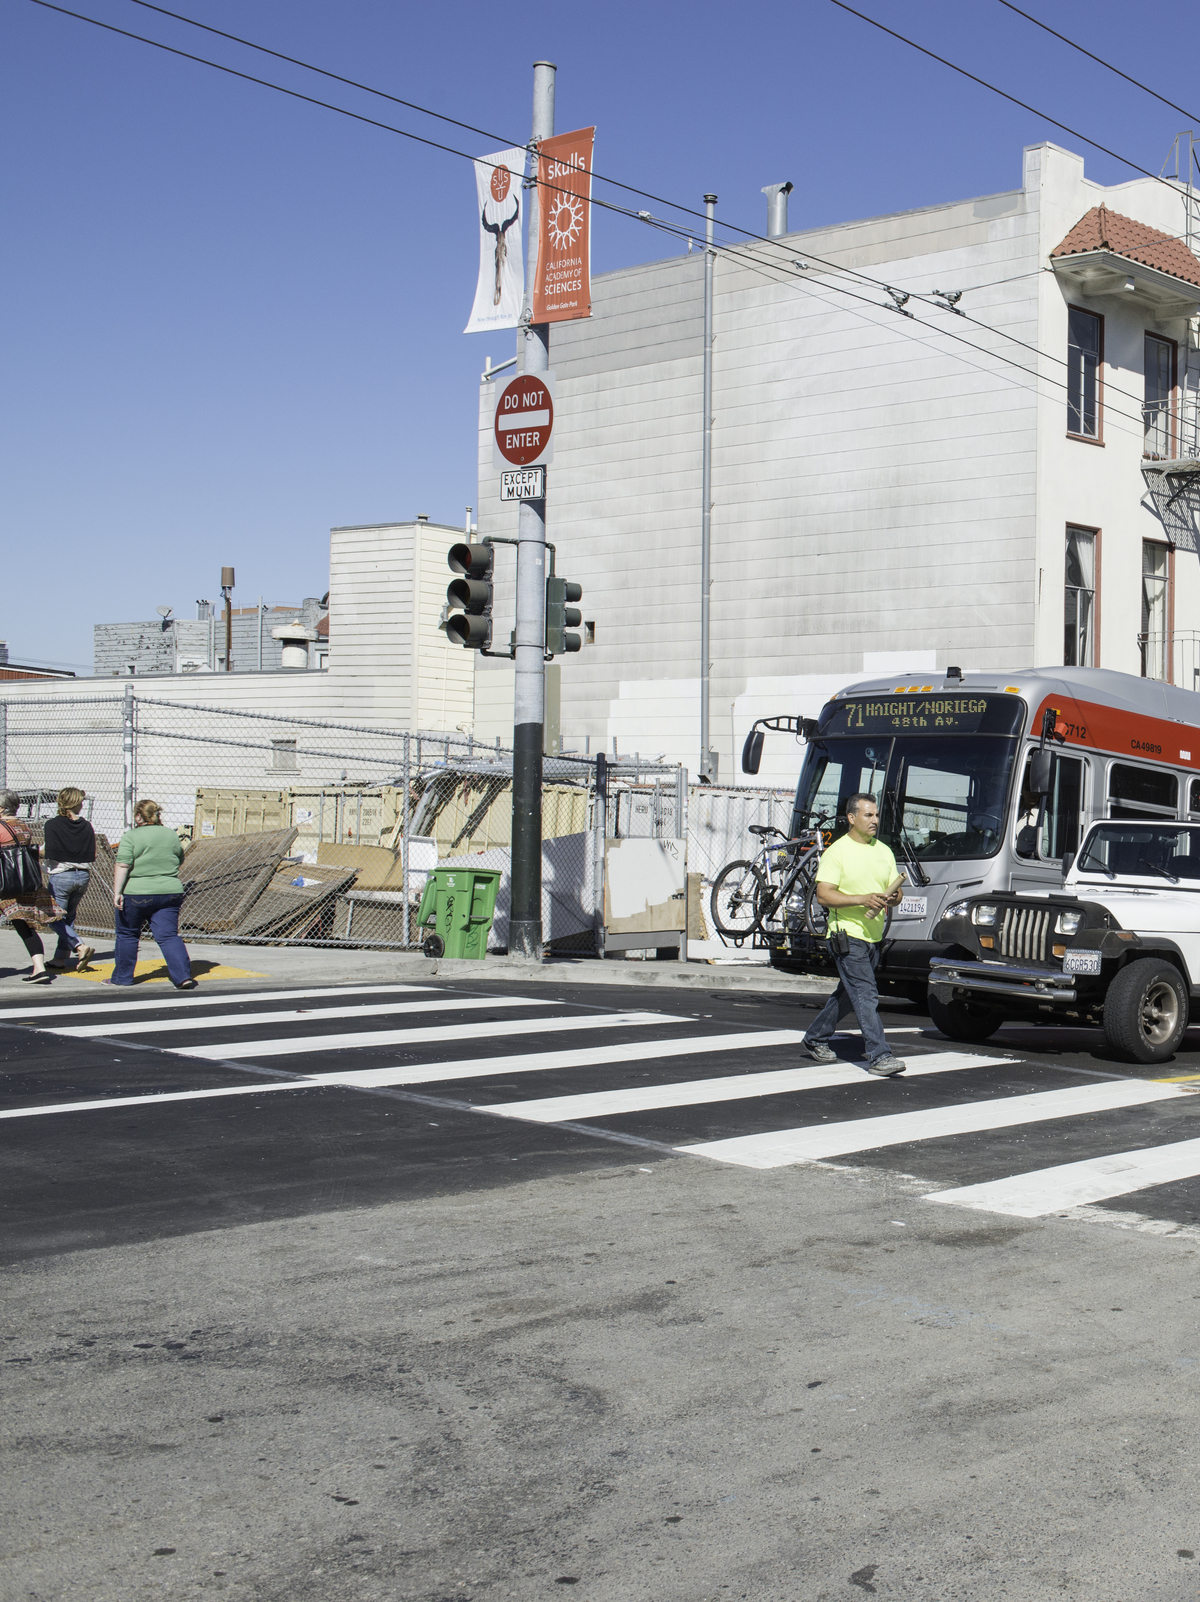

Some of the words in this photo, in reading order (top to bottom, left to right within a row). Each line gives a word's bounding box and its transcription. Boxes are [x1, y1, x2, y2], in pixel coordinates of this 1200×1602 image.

[547, 152, 586, 180] skulls
[545, 256, 583, 271] CALIFORNIA
[544, 269, 573, 282] ACADEMY
[573, 267, 582, 278] OF
[544, 279, 582, 296] SCIENCES
[504, 394, 519, 410] DO
[522, 390, 545, 408] NOT
[505, 431, 541, 449] ENTER
[504, 471, 539, 486] EXCEPT
[506, 484, 536, 498] MUNI
[845, 703, 865, 727] 71
[865, 699, 987, 717] HAIGHT/NORIEGA
[891, 717, 928, 727] 48th
[935, 715, 959, 726] Av.
[1130, 739, 1162, 755] CA49819
[899, 902, 925, 913] 1421196
[1065, 958, 1099, 972] 6CGR530
